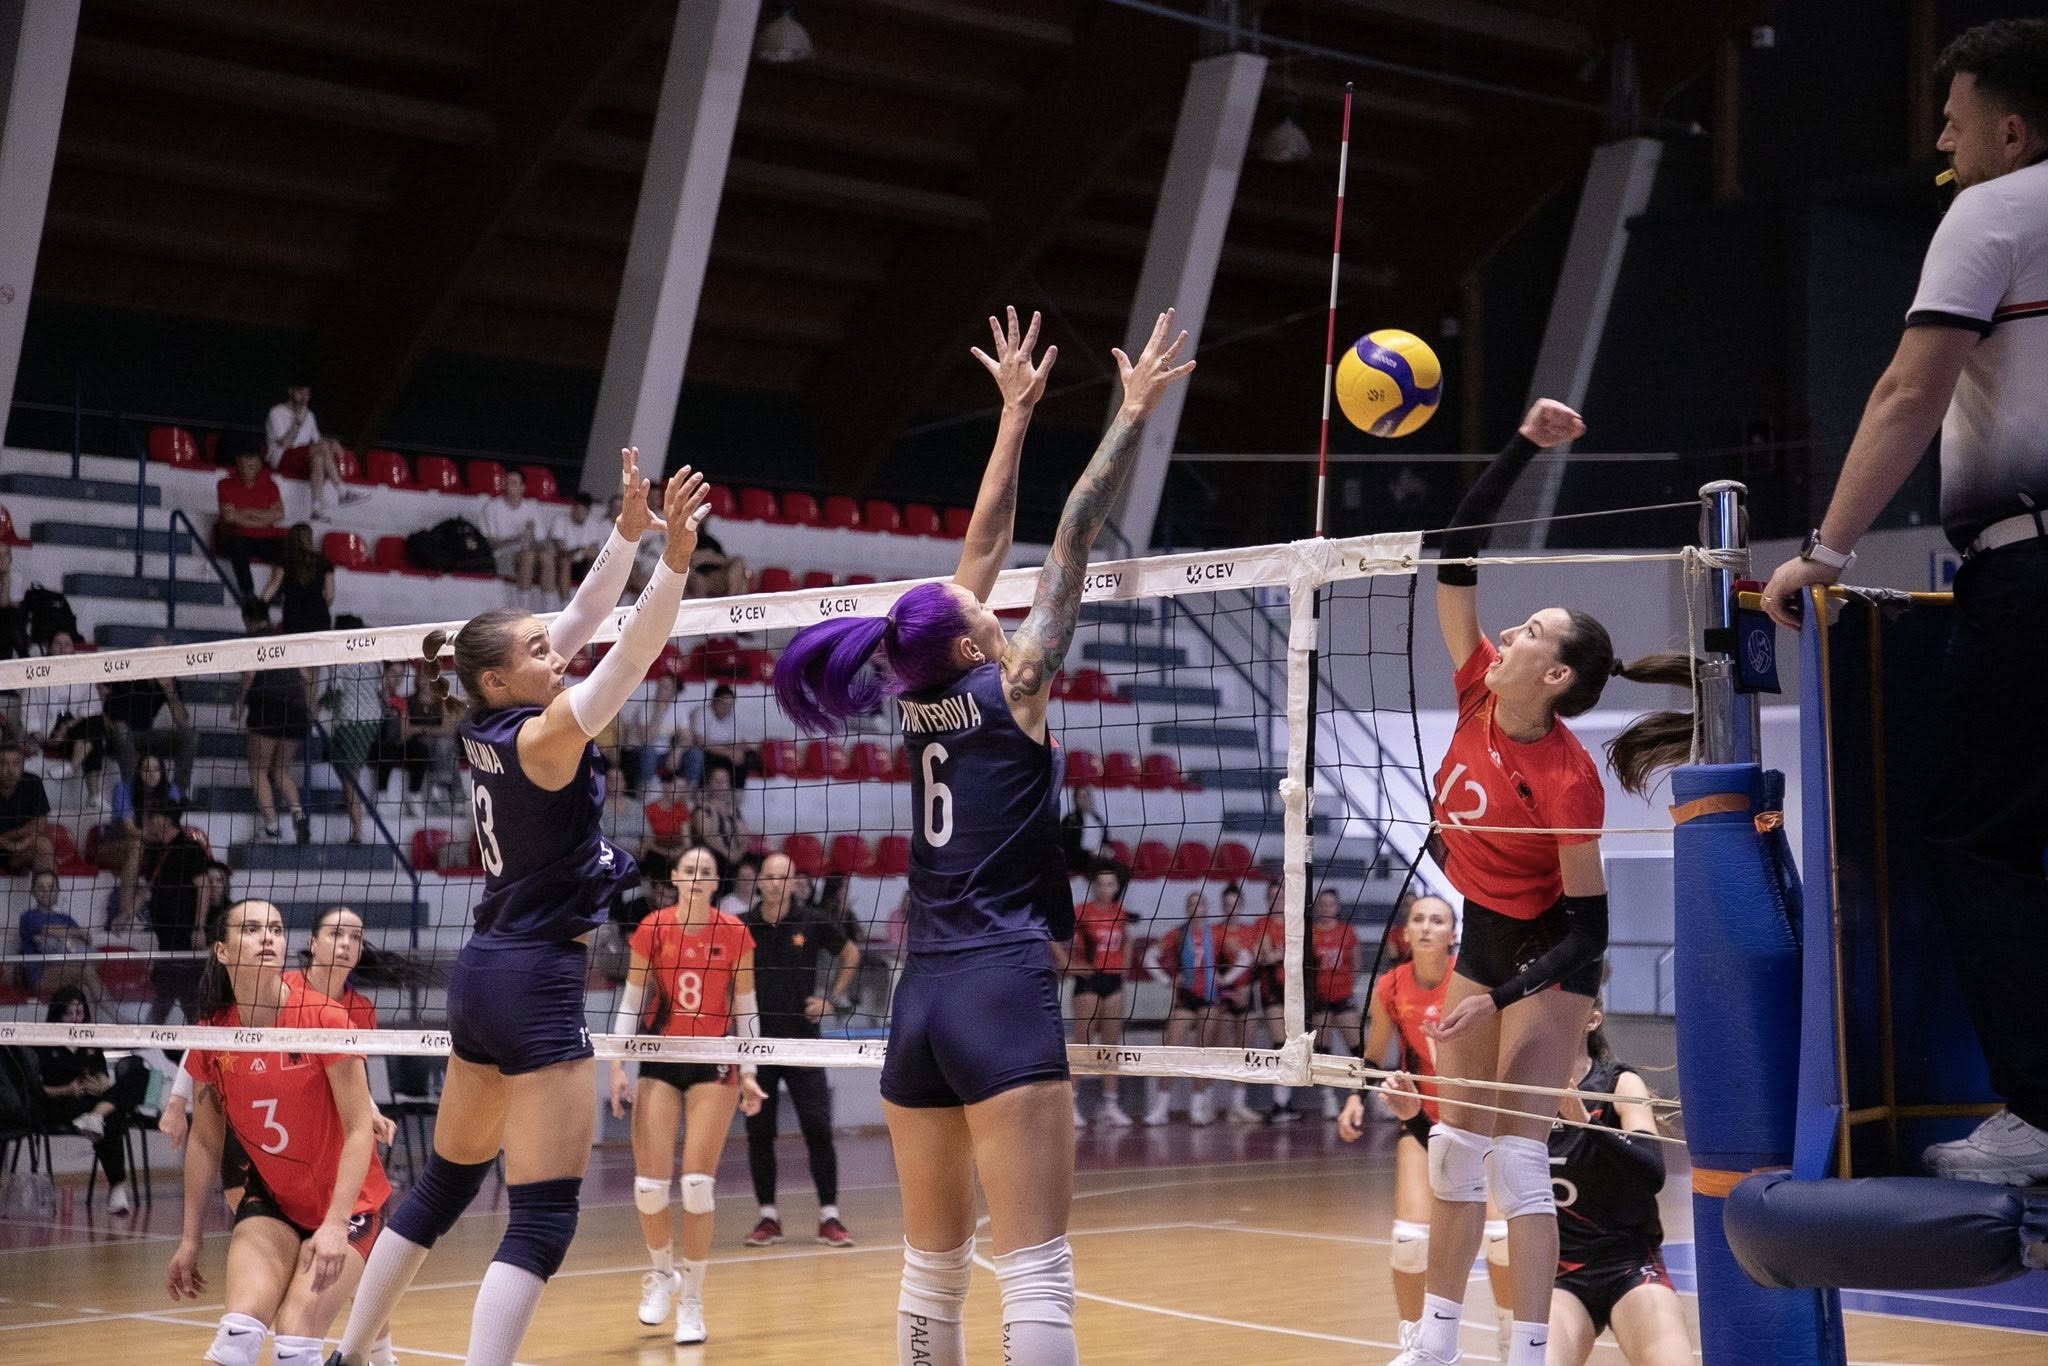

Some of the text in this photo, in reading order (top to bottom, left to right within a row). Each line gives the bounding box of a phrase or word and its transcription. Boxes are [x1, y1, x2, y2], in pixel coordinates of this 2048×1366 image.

[1205, 562, 1234, 579] CEV
[1096, 573, 1122, 589] CEV
[745, 606, 766, 620] CEV
[835, 599, 858, 613] CEV
[358, 637, 377, 648] CEV
[197, 652, 213, 664] CEV
[269, 645, 286, 659] CEV
[36, 665, 50, 677] CEV
[115, 659, 130, 671] CEV
[922, 742, 953, 848] 6
[1438, 763, 1488, 834] 12
[471, 779, 504, 877] 13
[679, 971, 702, 1010] 8
[252, 1098, 289, 1154] 3
